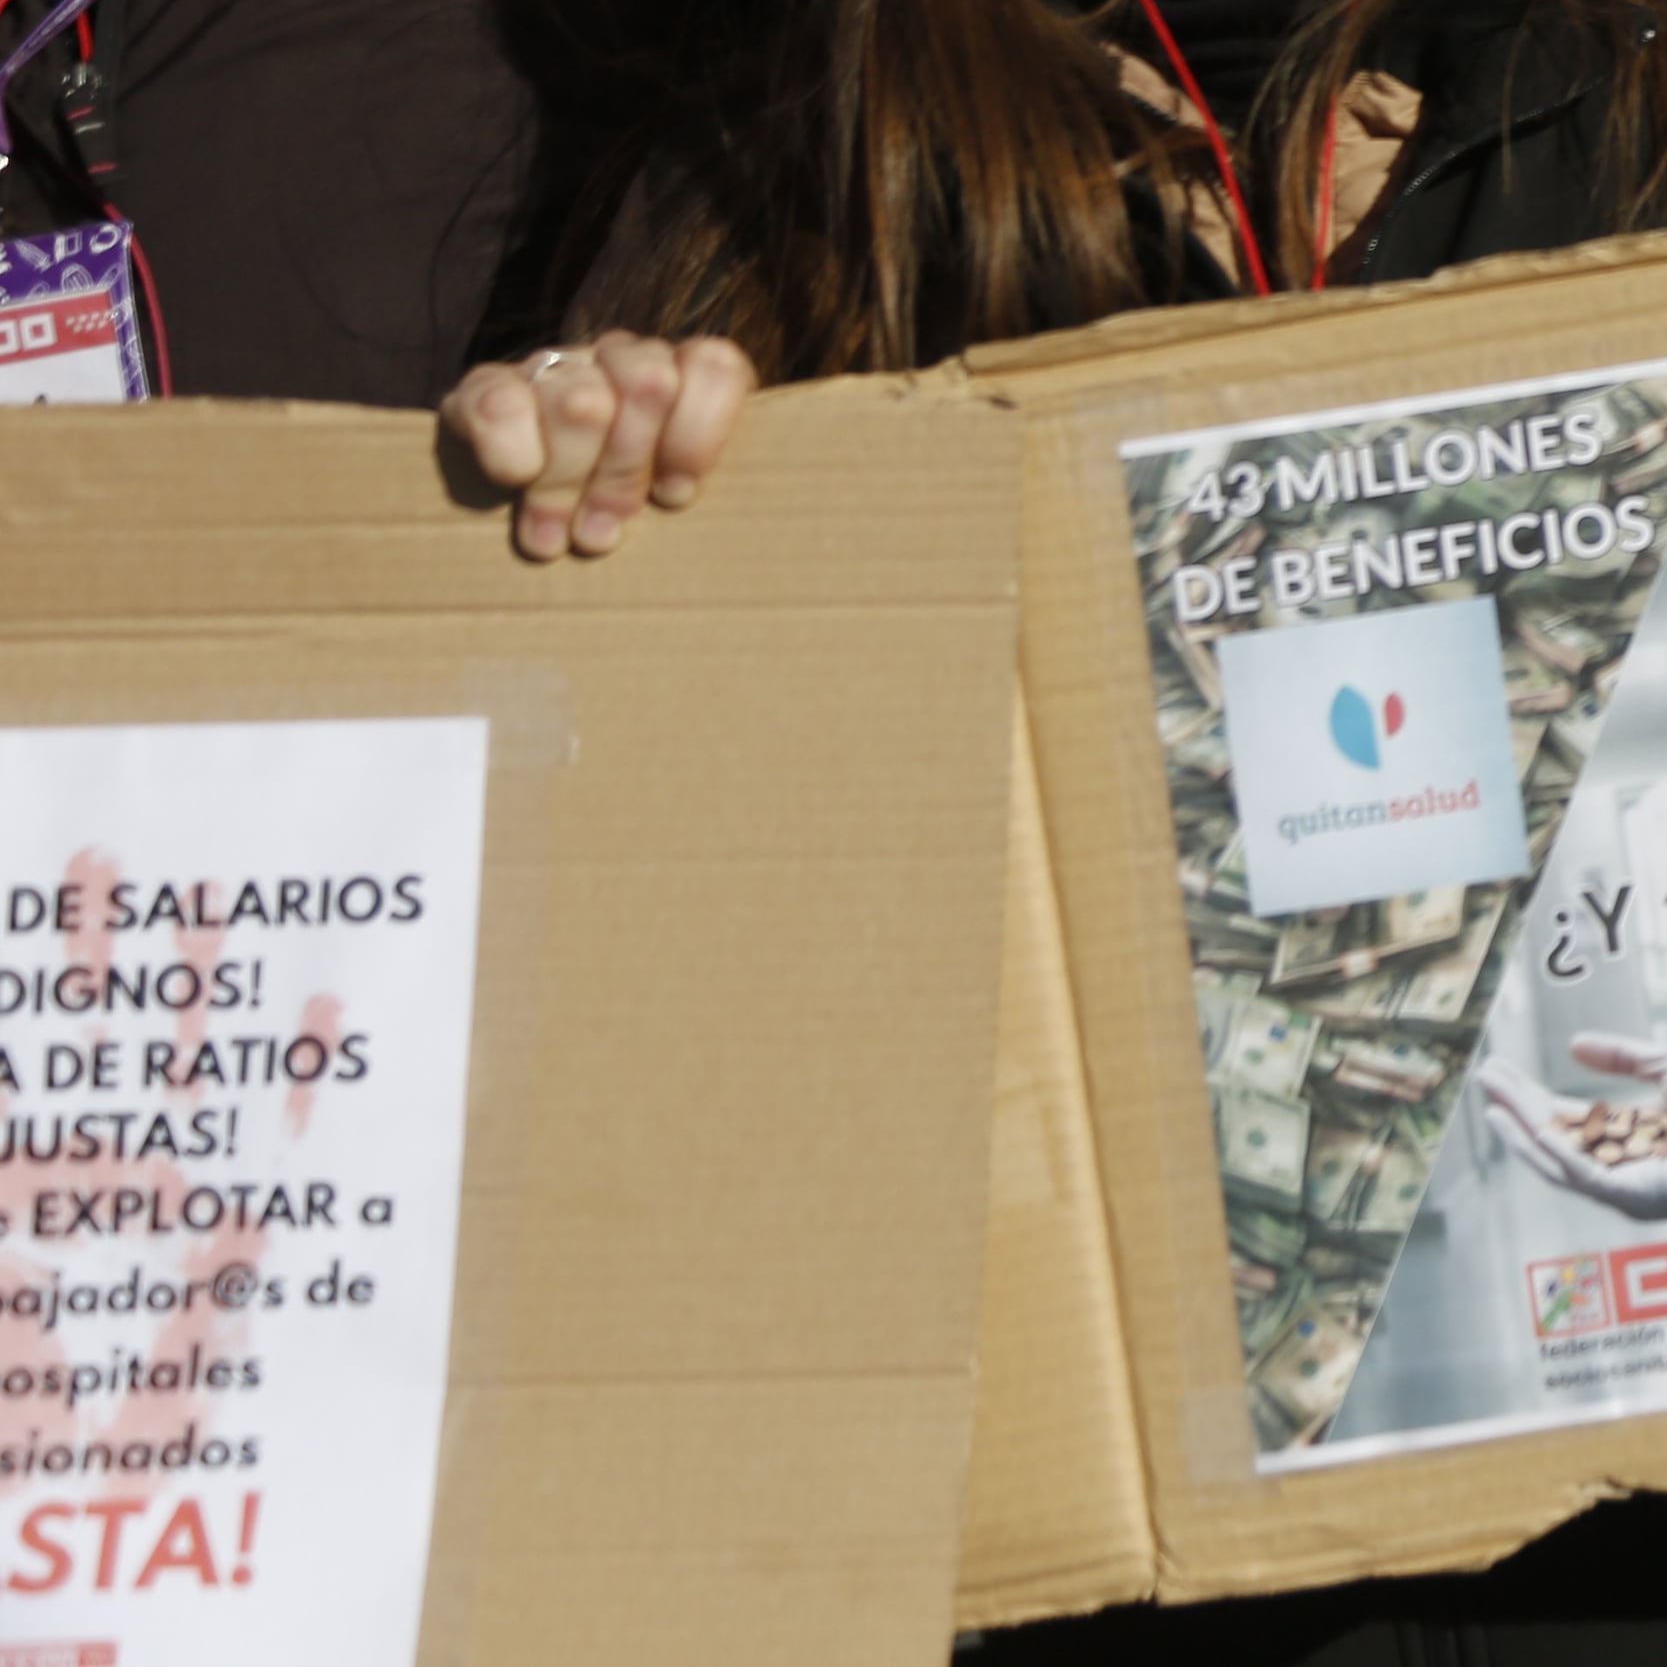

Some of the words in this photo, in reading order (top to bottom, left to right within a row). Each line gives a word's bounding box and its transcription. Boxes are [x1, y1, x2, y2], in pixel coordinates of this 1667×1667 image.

[1187, 460, 1266, 523] 43
[1276, 413, 1603, 512] MILLONES
[1172, 555, 1261, 624] DE
[1270, 494, 1656, 609] BENEFICIOS
[1277, 779, 1482, 846] quitansalud
[9, 885, 82, 933] DE
[105, 876, 424, 931] SALARIOS
[1546, 884, 1633, 979] ¿Y
[0, 961, 262, 1015] DIGNOS!
[46, 1043, 119, 1090] DE
[143, 1034, 369, 1088] RATIOS
[0, 1107, 238, 1165] JUSTAS!
[32, 1184, 336, 1238] EXPLOTAR
[361, 1197, 393, 1226] a
[0, 1262, 284, 1331] ajador@s
[307, 1261, 374, 1306] de
[0, 1346, 261, 1408] ospitales
[0, 1424, 258, 1476] sionados
[5, 1491, 260, 1595] STA!
